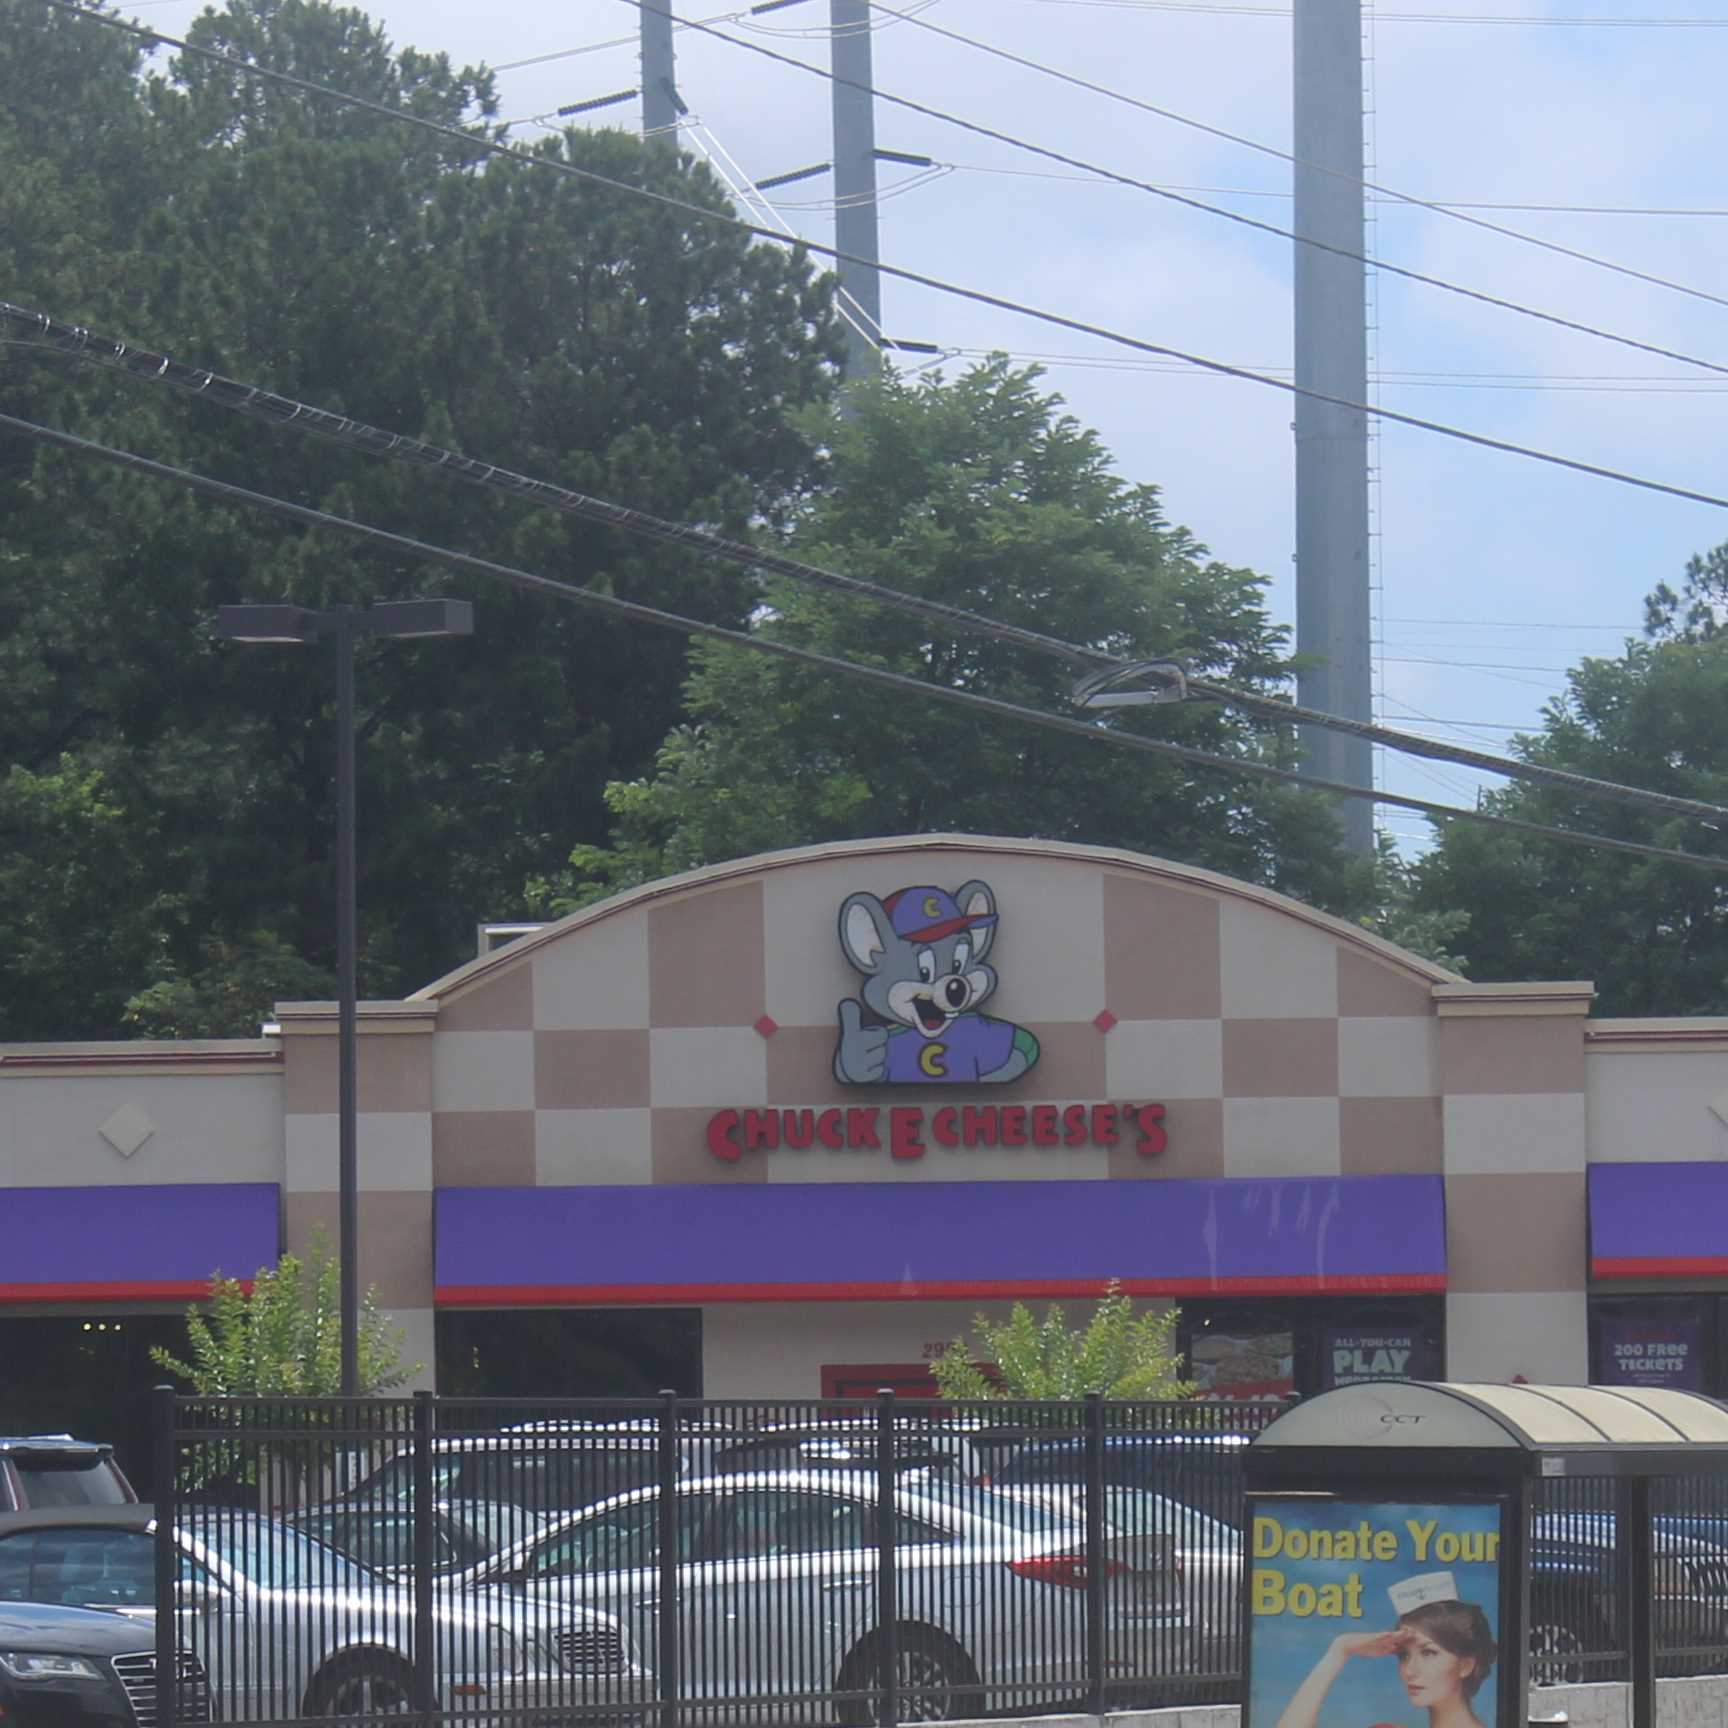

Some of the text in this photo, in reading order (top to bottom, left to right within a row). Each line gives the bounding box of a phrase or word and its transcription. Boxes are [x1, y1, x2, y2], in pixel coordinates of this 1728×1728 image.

[706, 1103, 1169, 1162] CHUCK E CHEESE'S
[1333, 1350, 1411, 1374] PLAY
[1614, 1343, 1643, 1356] 200
[1253, 1517, 1500, 1563] Donate Your
[1252, 1568, 1364, 1618] Boat
